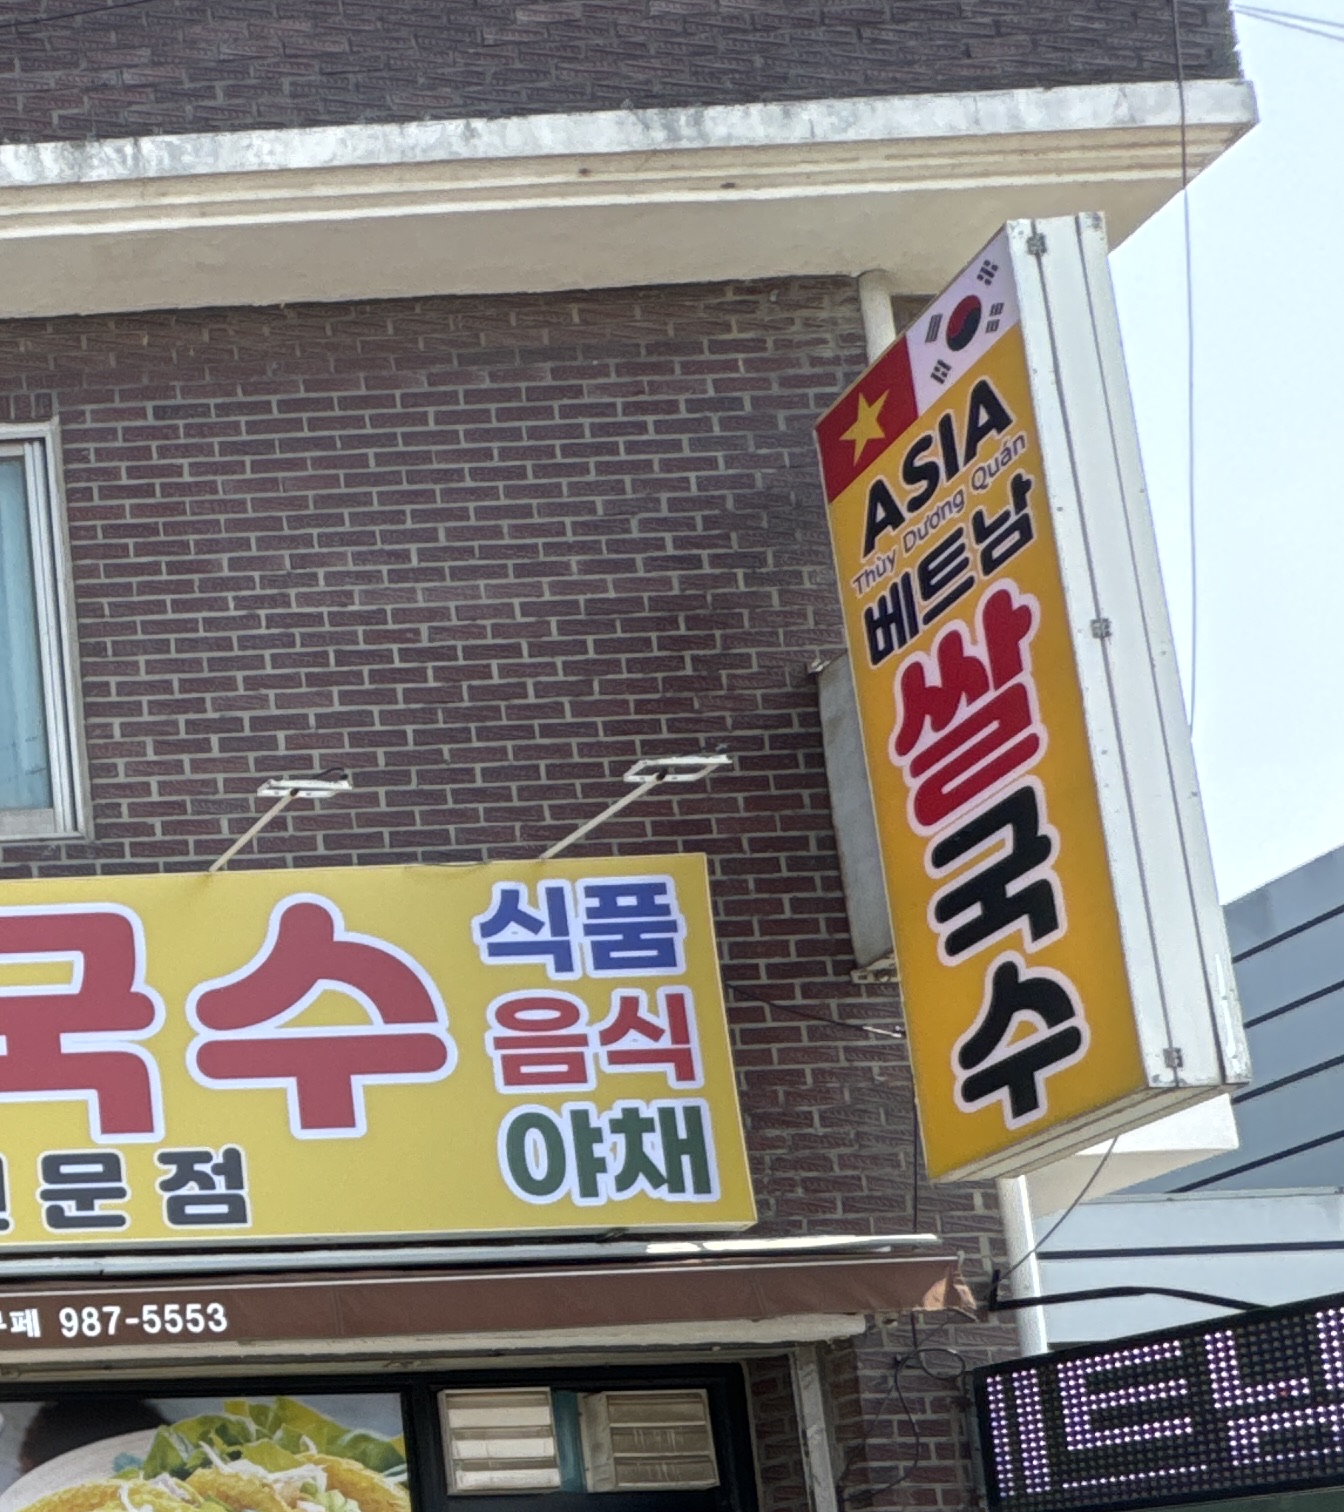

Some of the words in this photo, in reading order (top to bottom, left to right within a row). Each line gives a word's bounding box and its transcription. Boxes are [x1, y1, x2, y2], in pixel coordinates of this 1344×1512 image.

[853, 553, 897, 596] Thùy
[903, 488, 966, 555] Dương
[969, 430, 1029, 489] Quán
[861, 376, 1015, 558] ASIA
[864, 468, 1035, 668] 베트남
[888, 577, 1087, 1129] 쌀국수
[474, 876, 684, 979] 식품
[487, 985, 704, 1093] 음식
[499, 1098, 719, 1204] 야채
[58, 1302, 228, 1338] 987-5553
